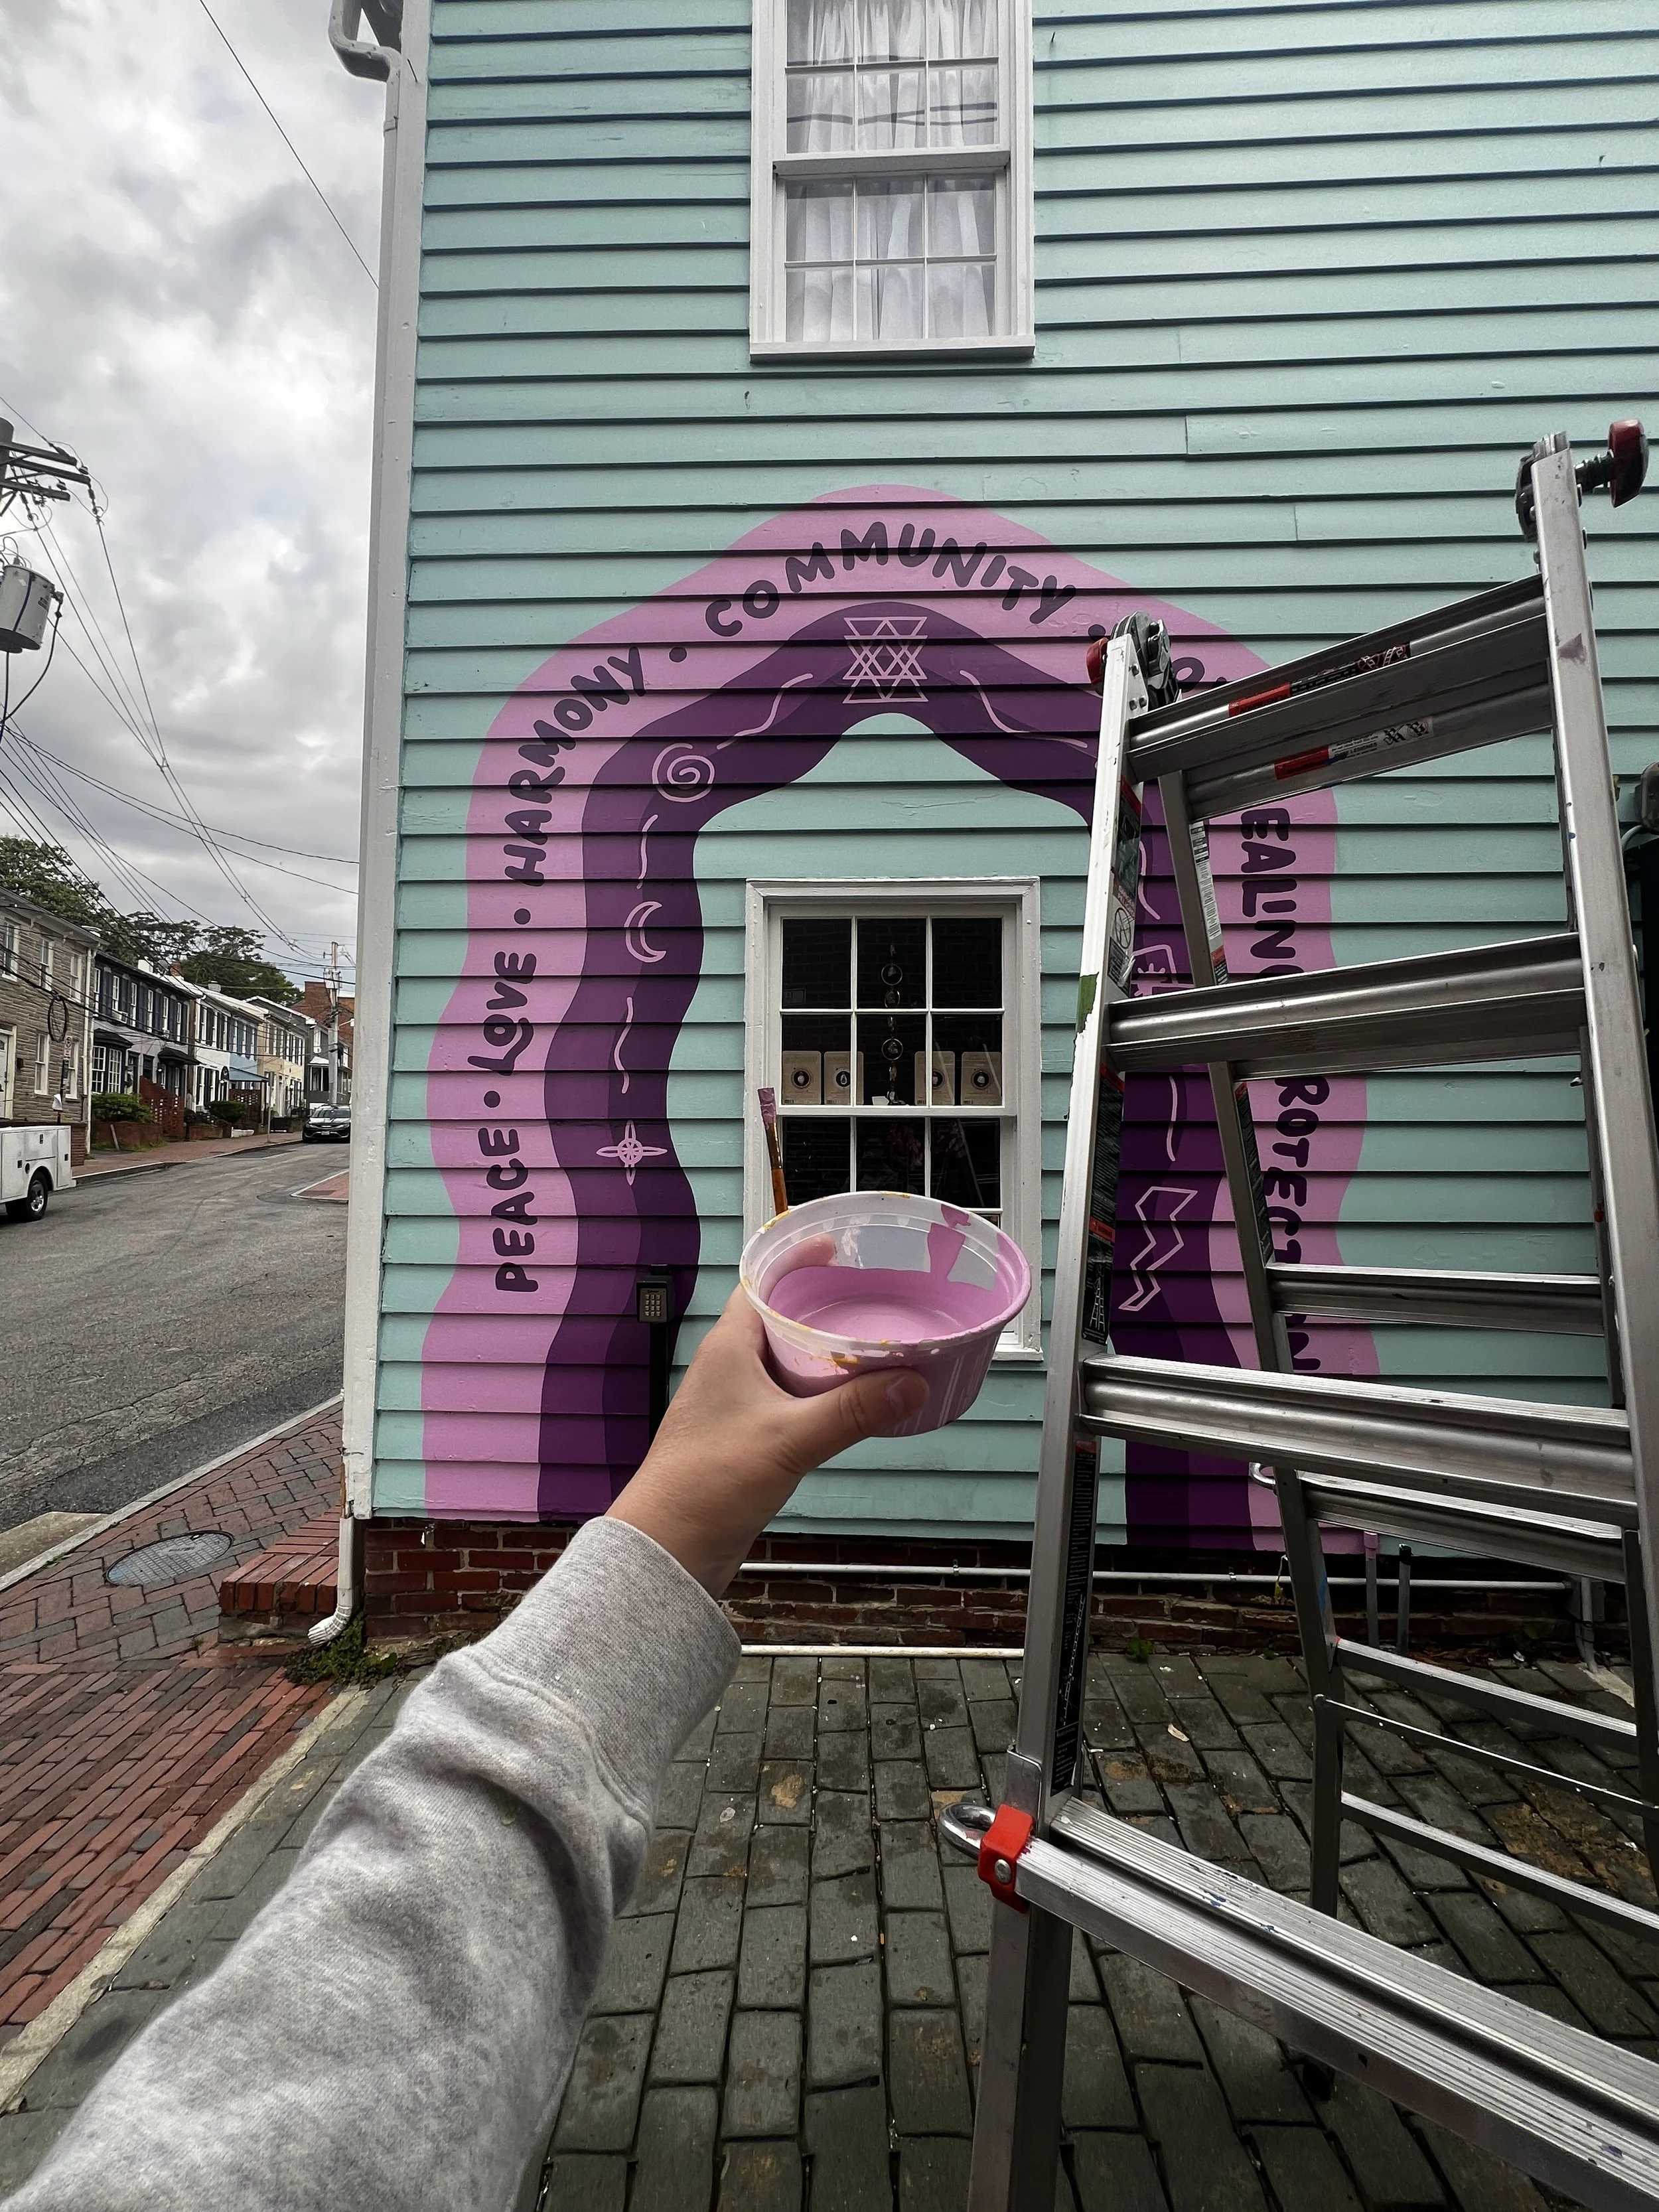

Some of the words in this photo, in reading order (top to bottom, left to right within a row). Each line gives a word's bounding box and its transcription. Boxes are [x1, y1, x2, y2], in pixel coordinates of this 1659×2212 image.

[705, 522, 1076, 636] COMMUNITY
[504, 646, 646, 886] HARMONY
[1240, 808, 1305, 981] EALIN
[468, 950, 537, 1076] LOVE
[478, 1127, 538, 1292] PEACE
